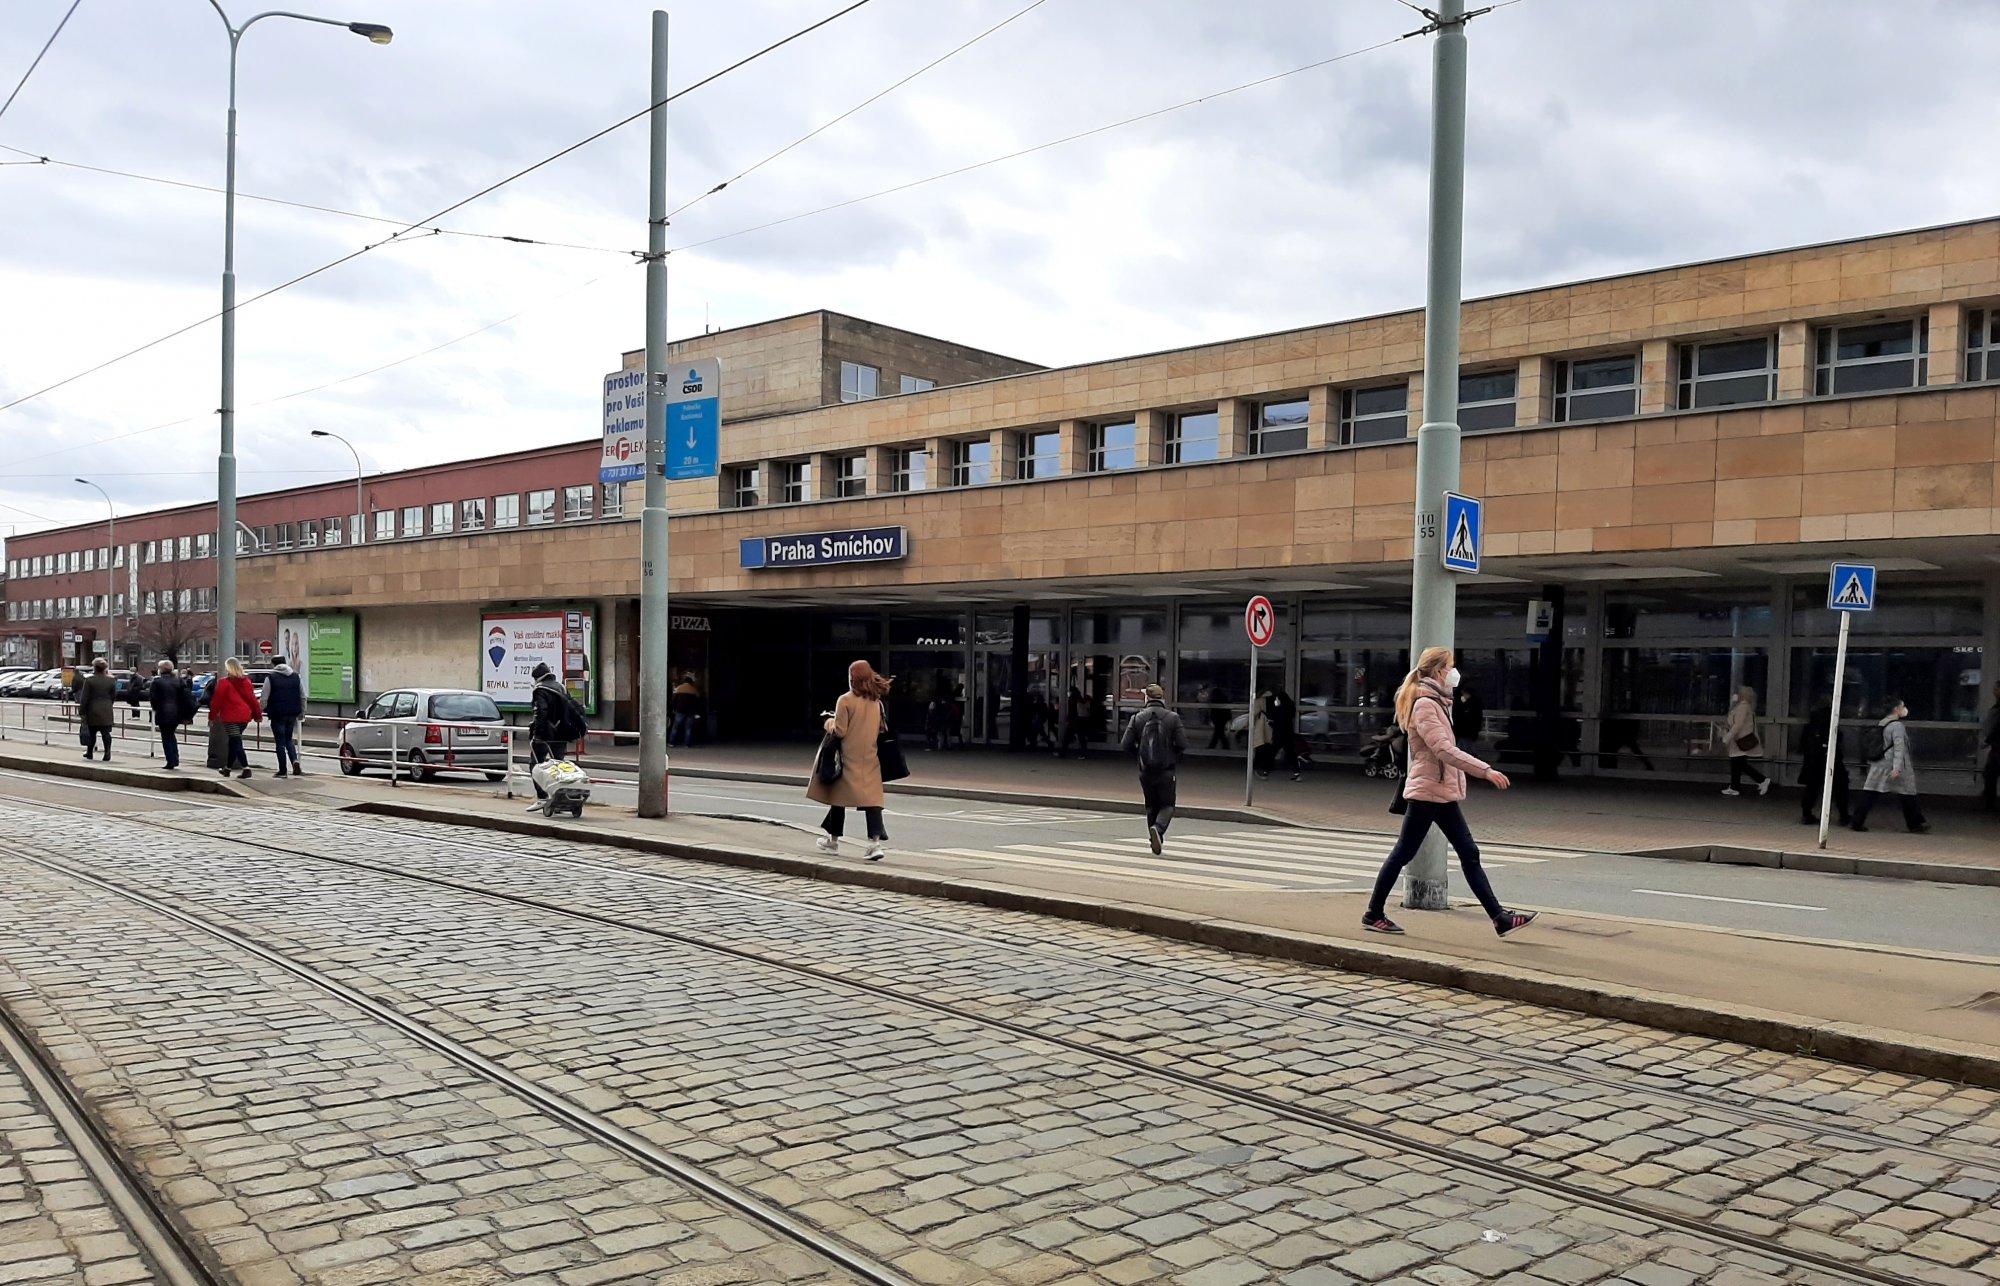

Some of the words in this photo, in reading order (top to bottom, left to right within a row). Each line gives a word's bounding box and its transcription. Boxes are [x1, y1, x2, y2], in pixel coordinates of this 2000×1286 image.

[607, 372, 644, 396] prostor
[607, 401, 622, 417] pro
[625, 391, 644, 409] Vaši
[607, 417, 644, 435] reklamu
[1420, 527, 1434, 538] 55
[771, 539, 815, 561] Praha
[821, 535, 894, 559] Smíchov
[584, 622, 591, 630] C
[670, 615, 711, 631] PIZZA
